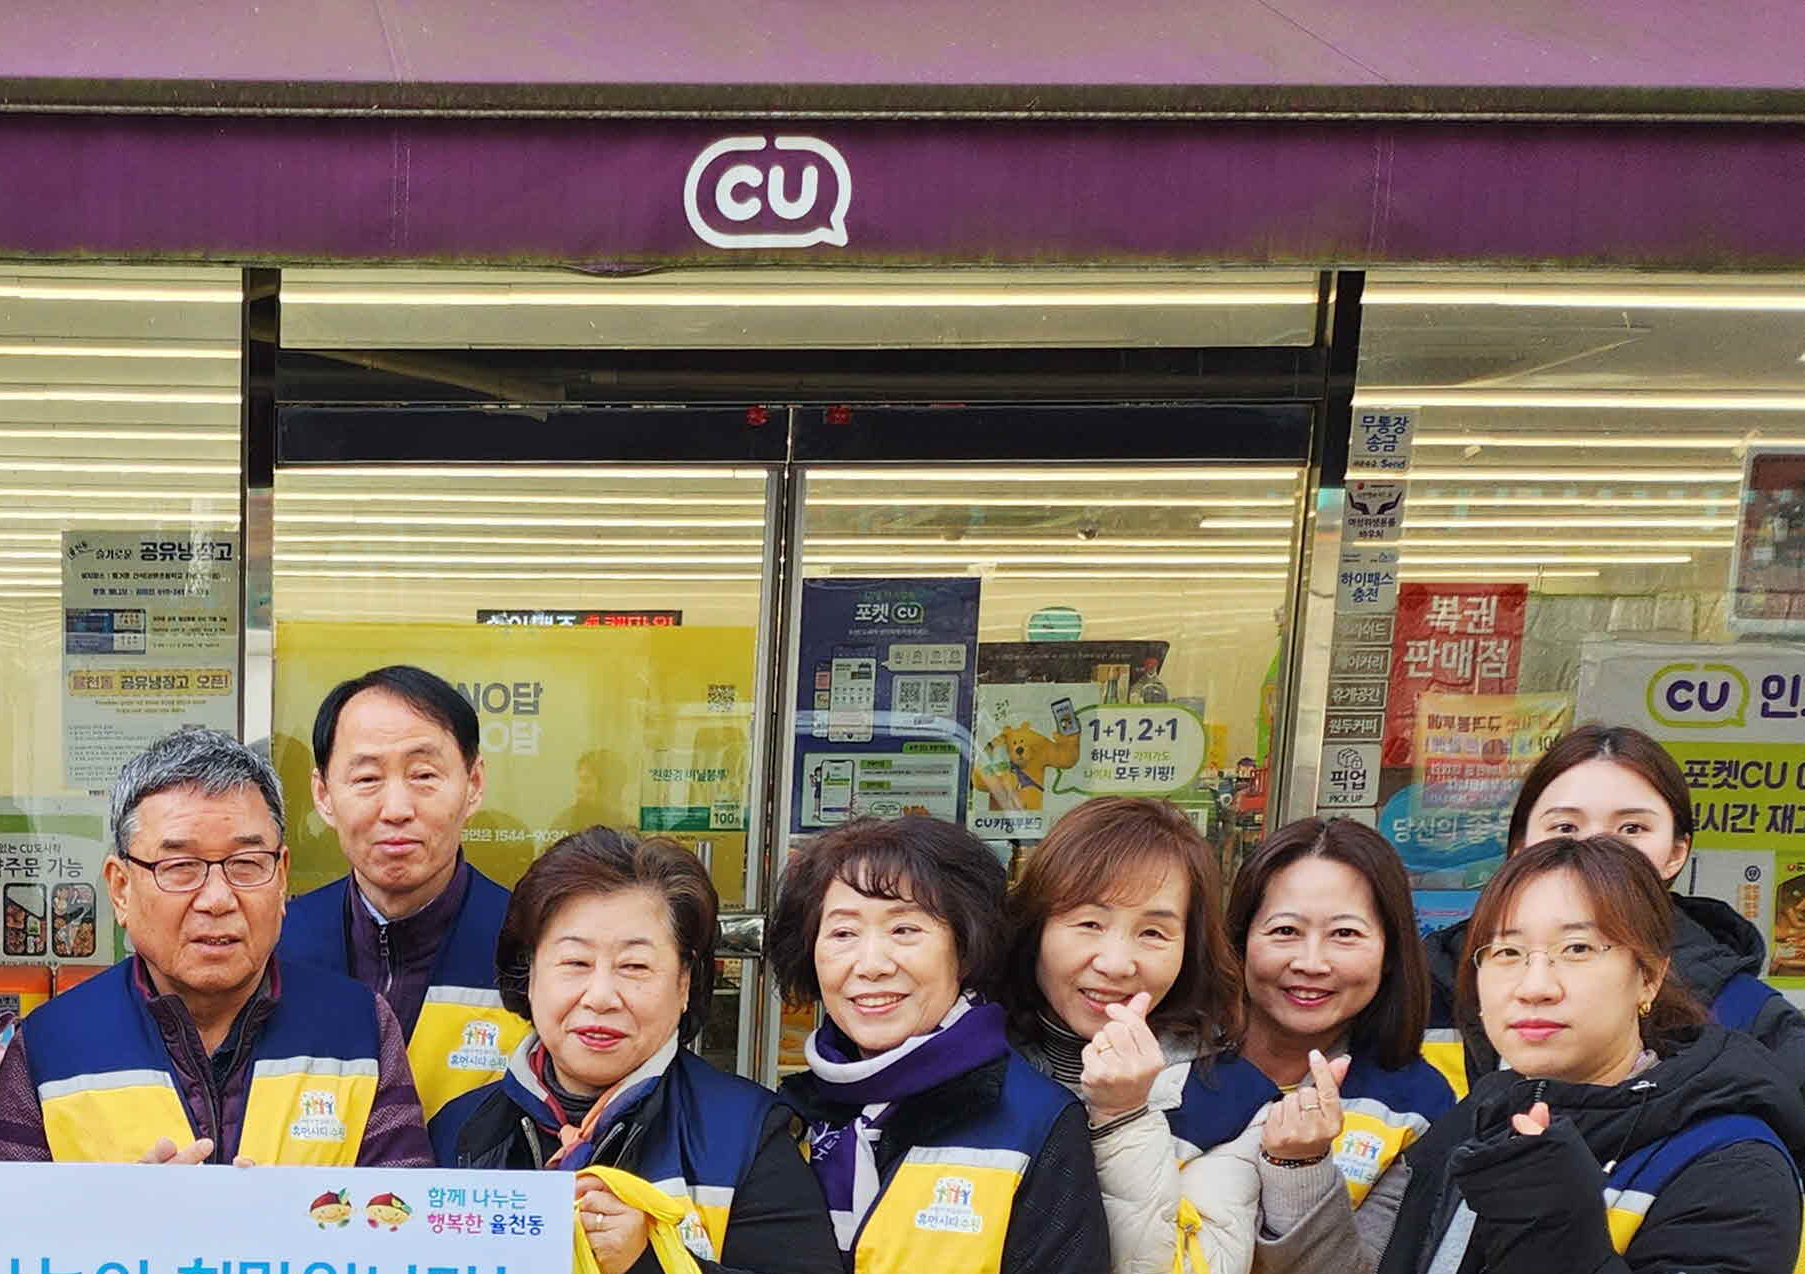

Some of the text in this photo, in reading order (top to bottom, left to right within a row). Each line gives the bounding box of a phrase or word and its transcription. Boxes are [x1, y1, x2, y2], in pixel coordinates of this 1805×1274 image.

[1361, 415, 1409, 435] 무통장
[1366, 434, 1398, 452] 송금
[141, 541, 232, 562] 공유냉장고
[1341, 572, 1393, 588] 하이패스
[854, 603, 889, 623] 포켓
[1426, 594, 1497, 635] 복권
[1403, 638, 1511, 679] 판매점
[121, 675, 190, 690] 공유냉장고
[1760, 673, 1805, 719] 인
[1331, 717, 1378, 734] 원두커피
[1090, 749, 1130, 764] 하나만
[1115, 764, 1176, 782] 모두 키핑!
[1330, 769, 1366, 790] 픽업
[1683, 759, 1788, 791] 포켓CU
[48, 857, 84, 878] 가능
[428, 1186, 529, 1210] 함께 나누는
[427, 1213, 545, 1236] 행복한 율천동
